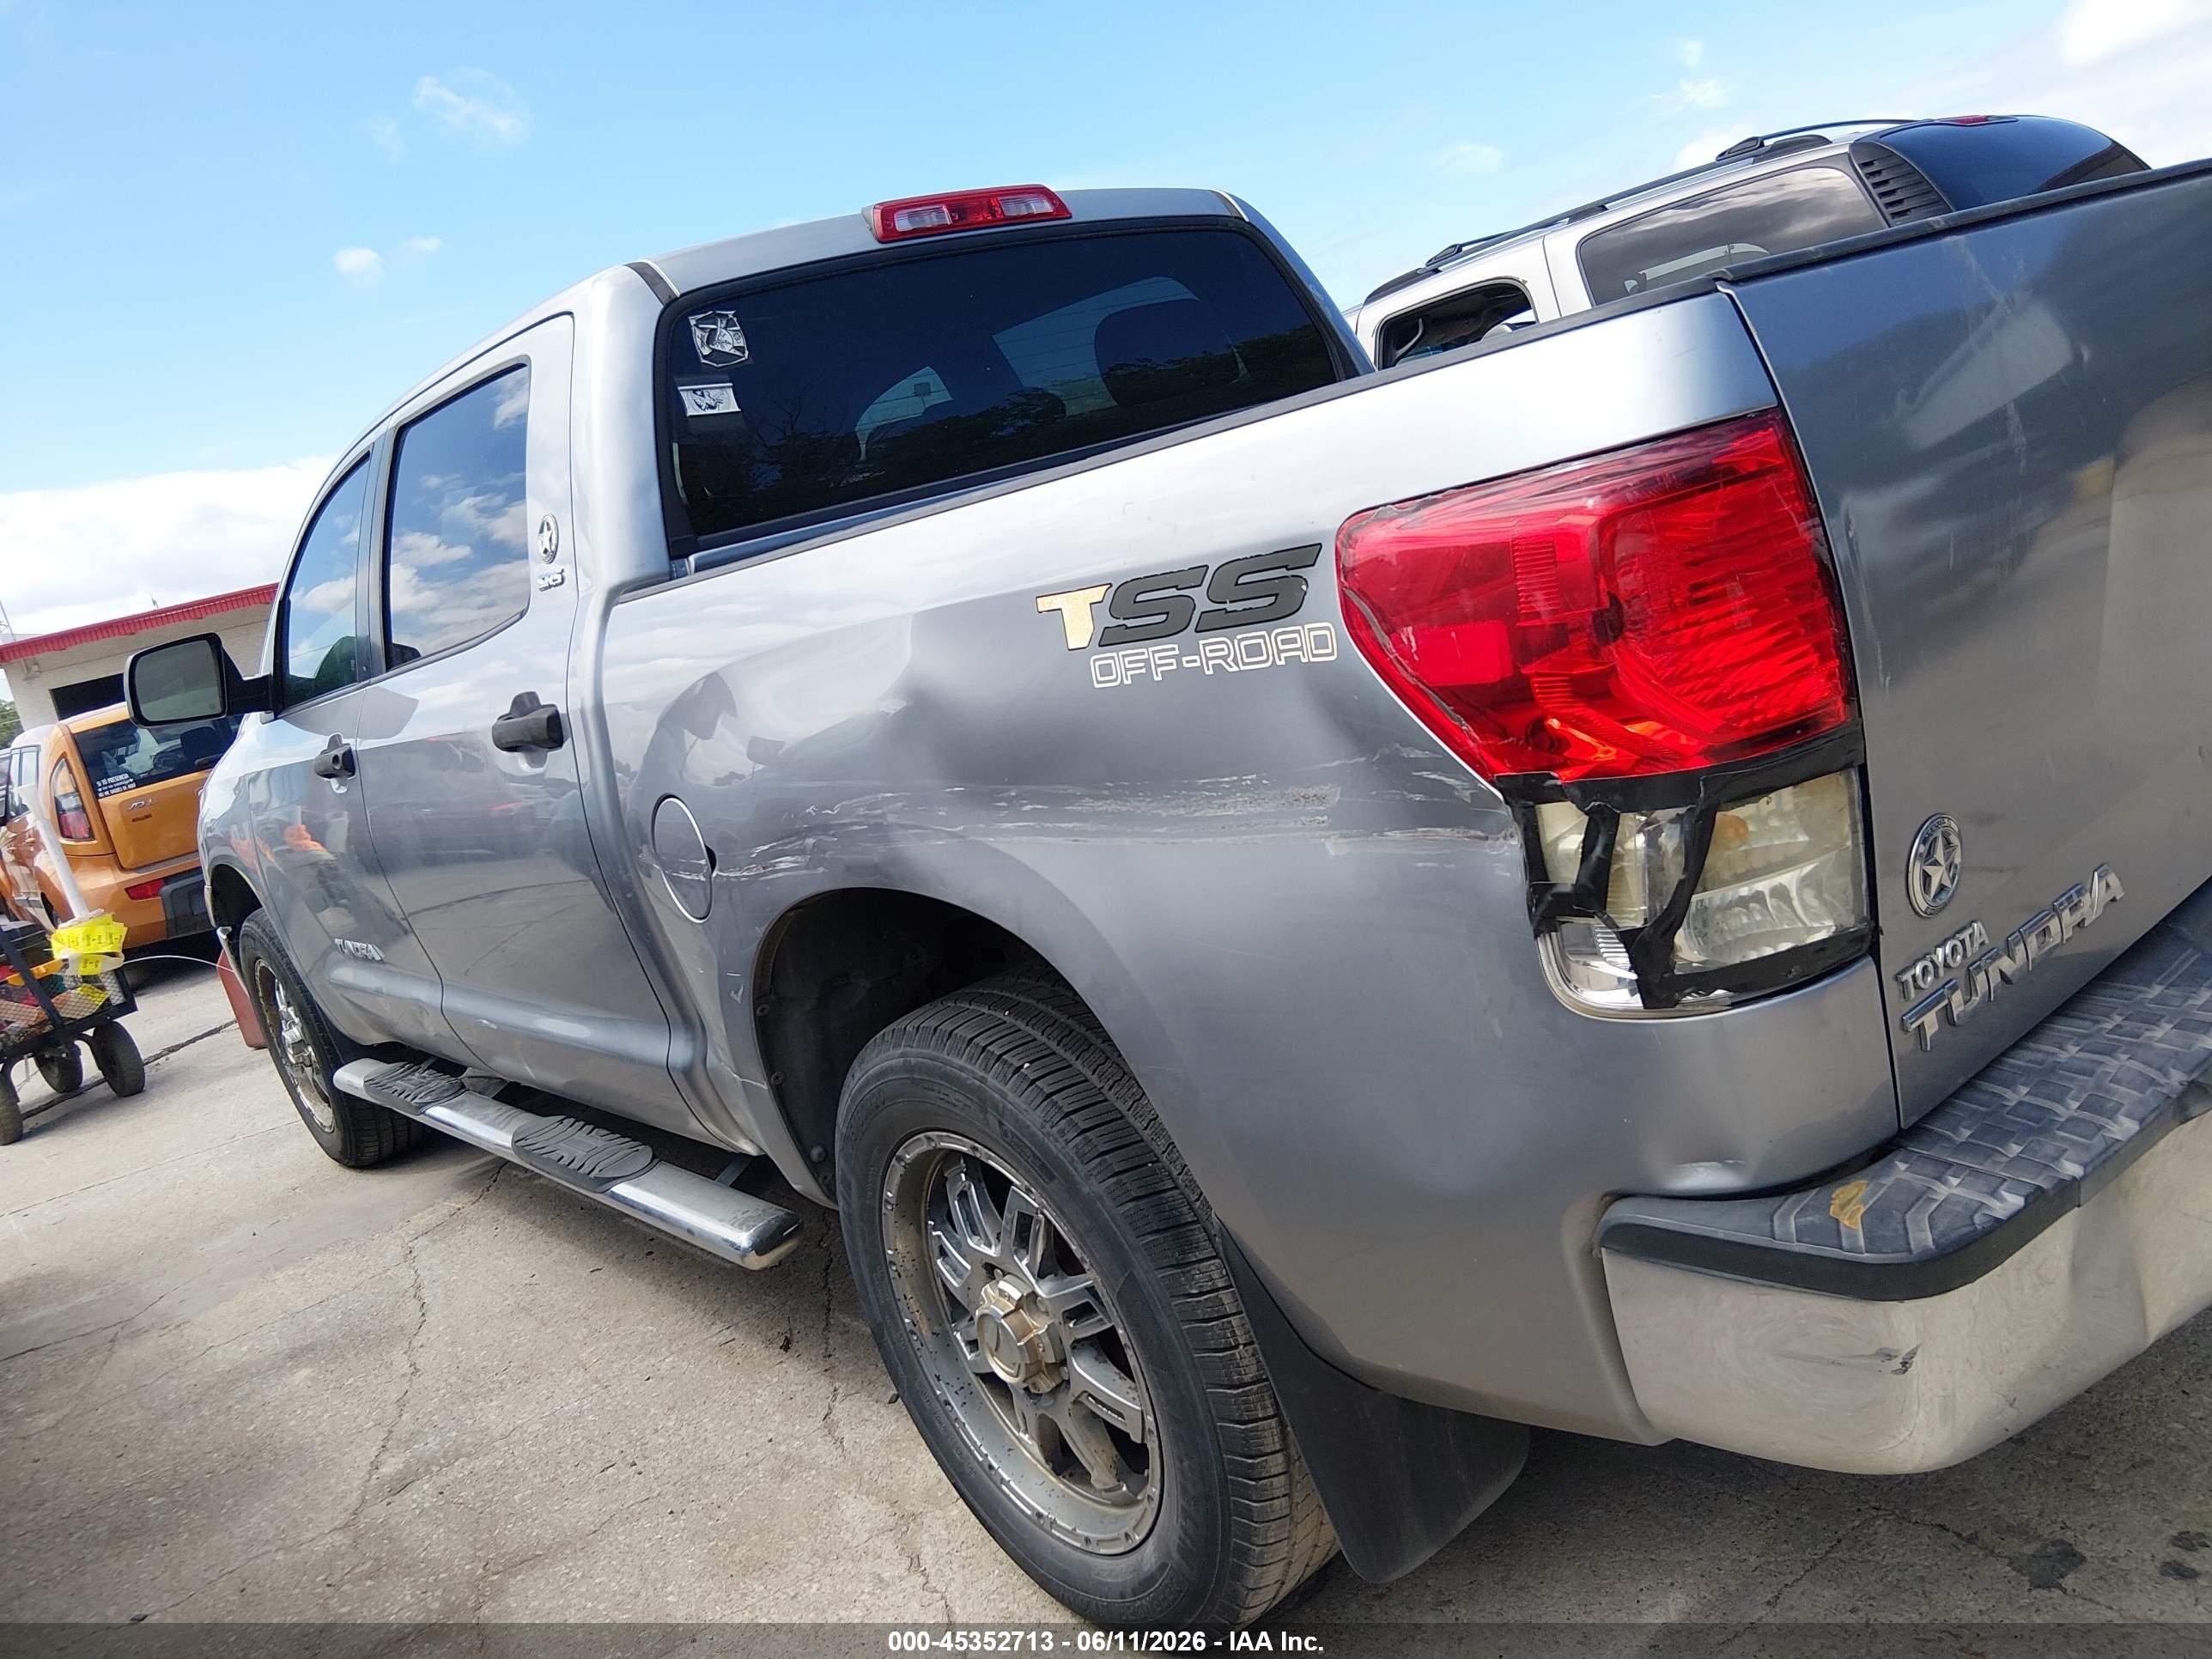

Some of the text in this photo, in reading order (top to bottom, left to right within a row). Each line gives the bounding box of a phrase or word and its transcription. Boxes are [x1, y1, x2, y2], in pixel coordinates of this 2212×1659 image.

[1036, 543, 1322, 651] TSS
[1090, 622, 1338, 689] OFF-ROAD
[333, 938, 386, 962] TUNDRA
[1895, 920, 1990, 1002] TOYOTA
[1901, 862, 2125, 1052] TUNDRA
